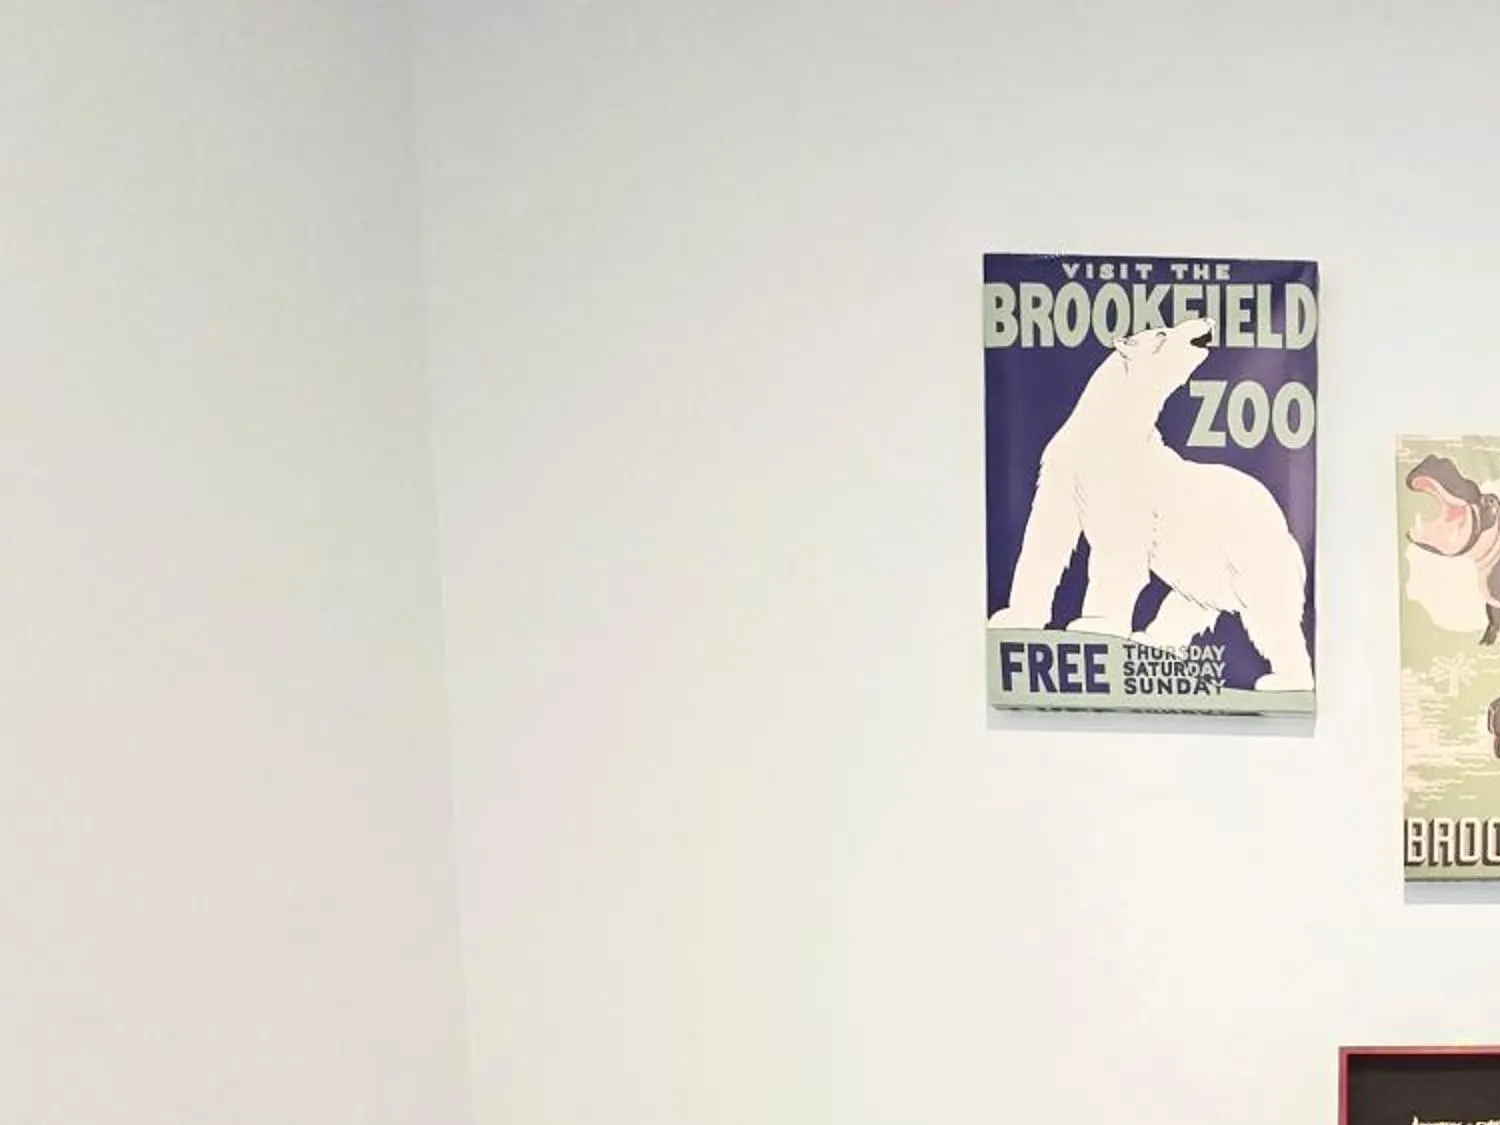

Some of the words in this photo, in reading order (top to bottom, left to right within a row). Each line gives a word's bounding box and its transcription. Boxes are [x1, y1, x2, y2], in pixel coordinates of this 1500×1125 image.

[1062, 263, 1152, 279] VISIT
[1171, 264, 1231, 280] THE
[984, 281, 1318, 350] BROOKFIELD
[1186, 379, 1316, 449] ZOO
[1123, 643, 1226, 661] THURSDAY
[1000, 642, 1111, 694] FREE
[1123, 661, 1226, 677] SATURDAY
[1124, 677, 1226, 695] SUNDAY
